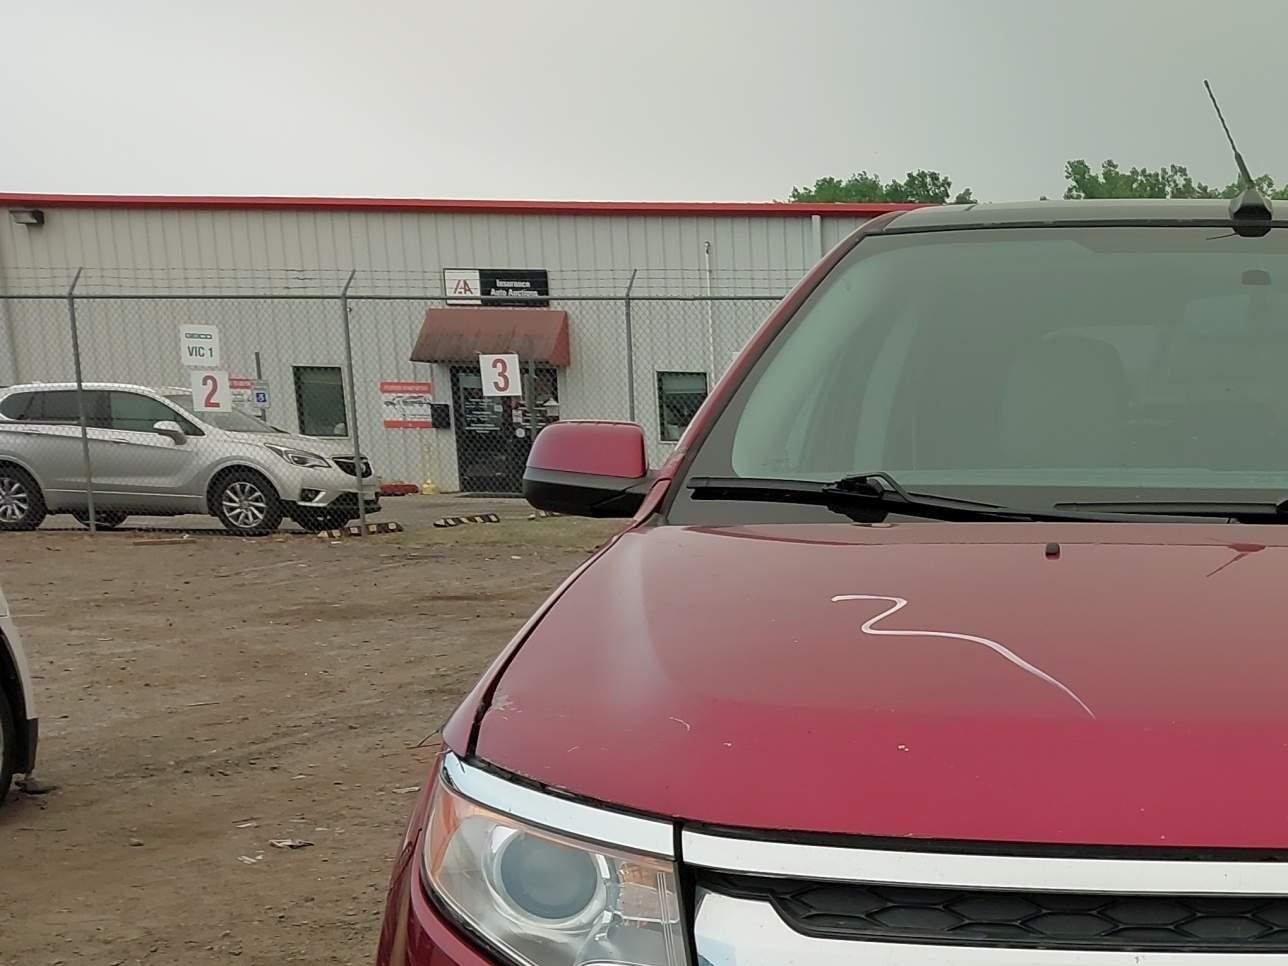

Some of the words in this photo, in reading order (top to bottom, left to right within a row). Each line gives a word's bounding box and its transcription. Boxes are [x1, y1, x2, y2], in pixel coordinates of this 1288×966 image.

[495, 279, 531, 288] Insurance
[490, 288, 507, 296] Auto
[508, 288, 539, 297] Auctions
[187, 345, 205, 357] VIC
[208, 347, 214, 358] 1
[491, 358, 510, 392] 3
[201, 375, 221, 408] 2
